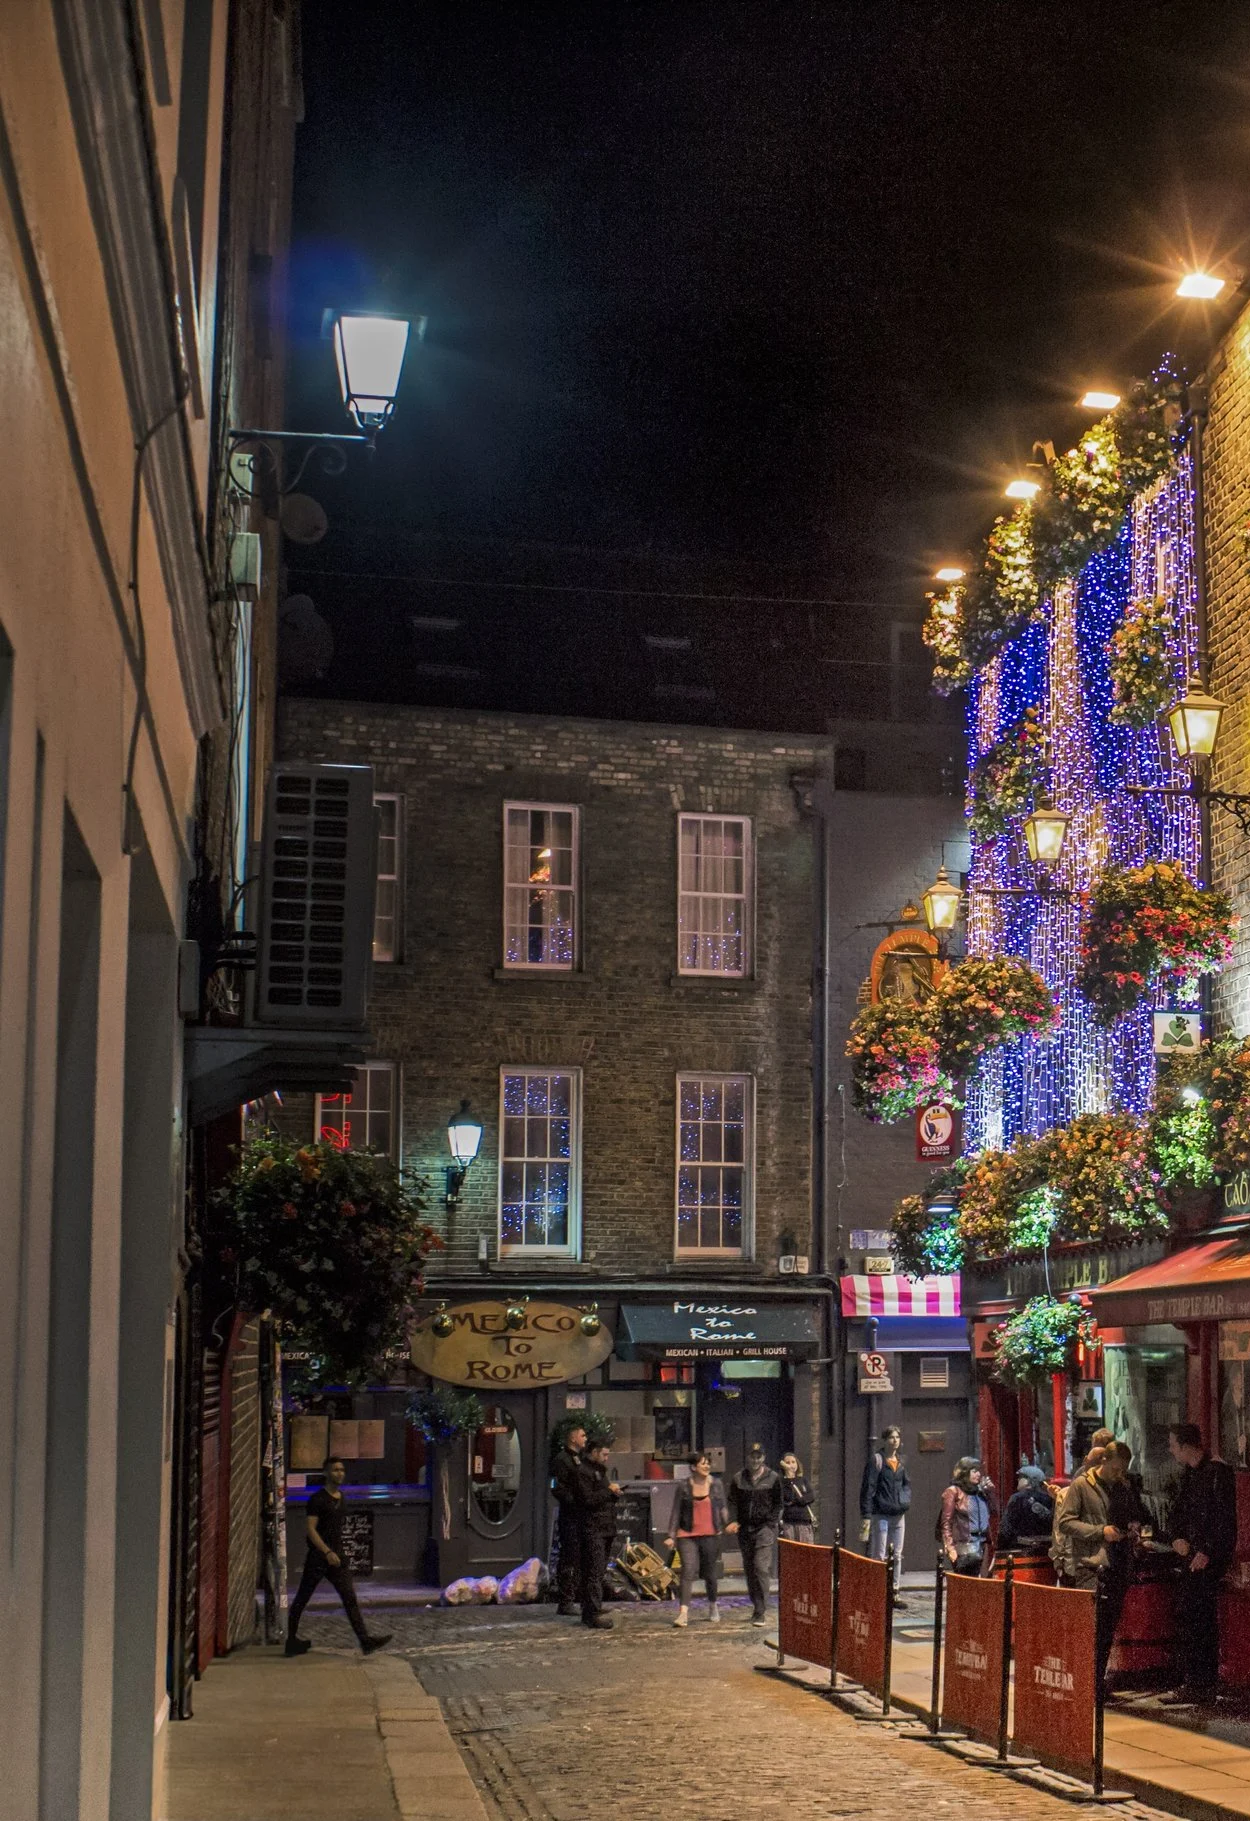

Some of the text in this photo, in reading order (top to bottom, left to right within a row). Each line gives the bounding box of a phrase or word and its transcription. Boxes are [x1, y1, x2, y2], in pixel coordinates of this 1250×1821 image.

[674, 1301, 758, 1315] Mexico
[1167, 1296, 1201, 1319] TEMPLE
[1203, 1294, 1224, 1316] BAR
[705, 1317, 733, 1328] to
[690, 1327, 757, 1341] Rome
[666, 1347, 787, 1357] MEXICAN ITALIAN GRILL HOUSE
[464, 1360, 563, 1383] ROME
